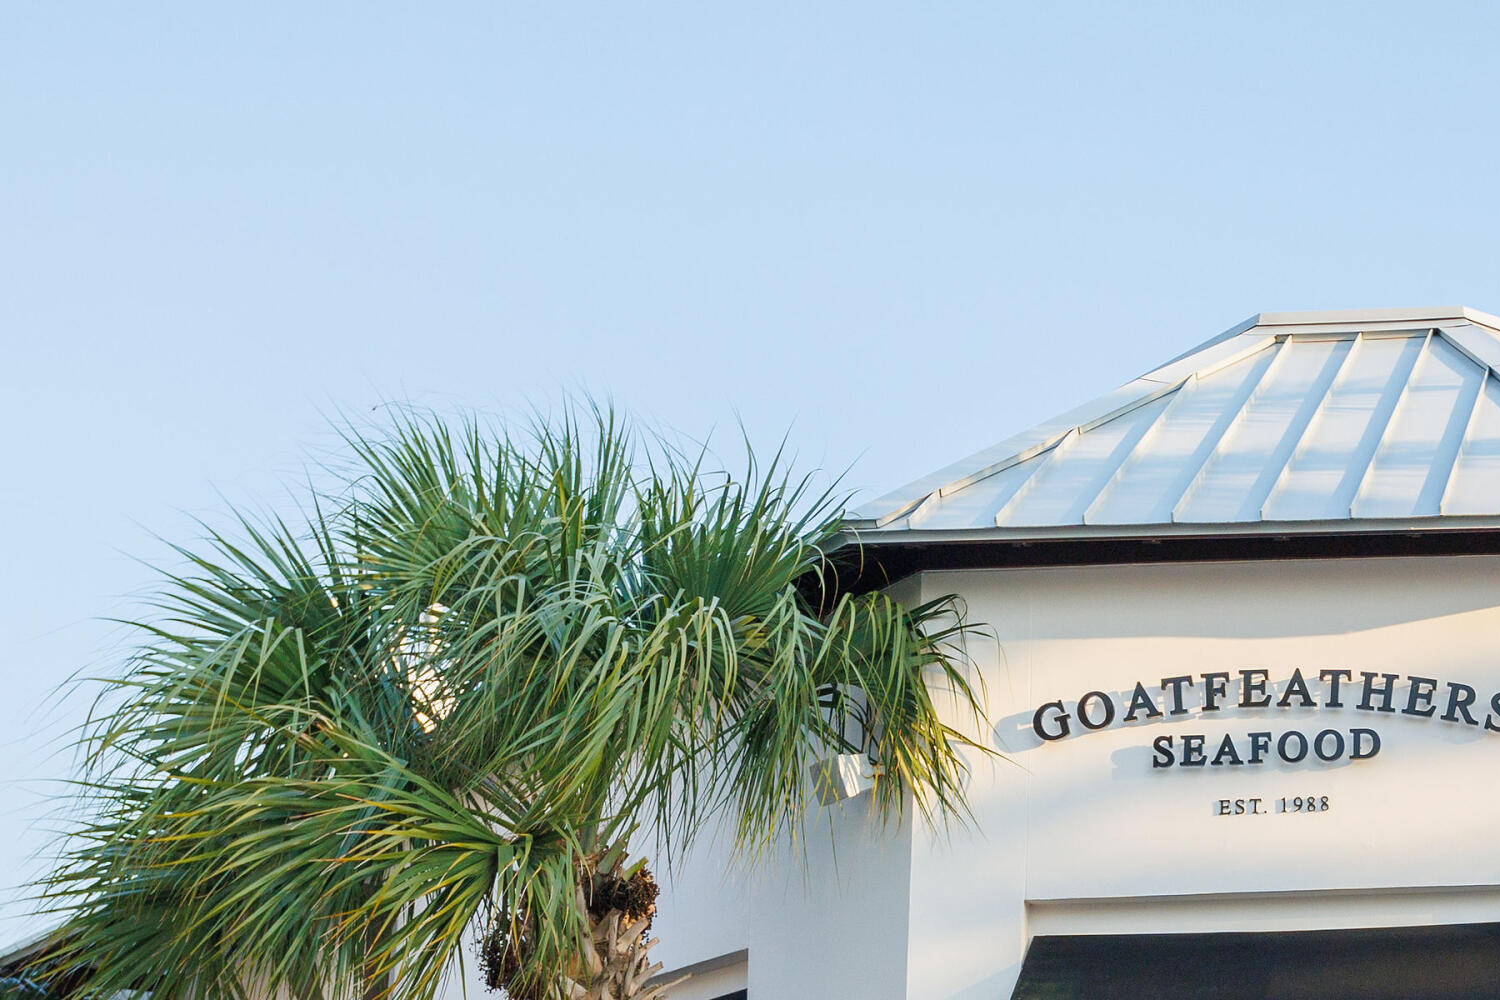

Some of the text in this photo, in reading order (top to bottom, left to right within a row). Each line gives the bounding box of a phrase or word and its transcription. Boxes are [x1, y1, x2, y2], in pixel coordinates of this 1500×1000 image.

[1151, 727, 1382, 769] SEAFOOD
[1218, 795, 1330, 816] EST. 1988
